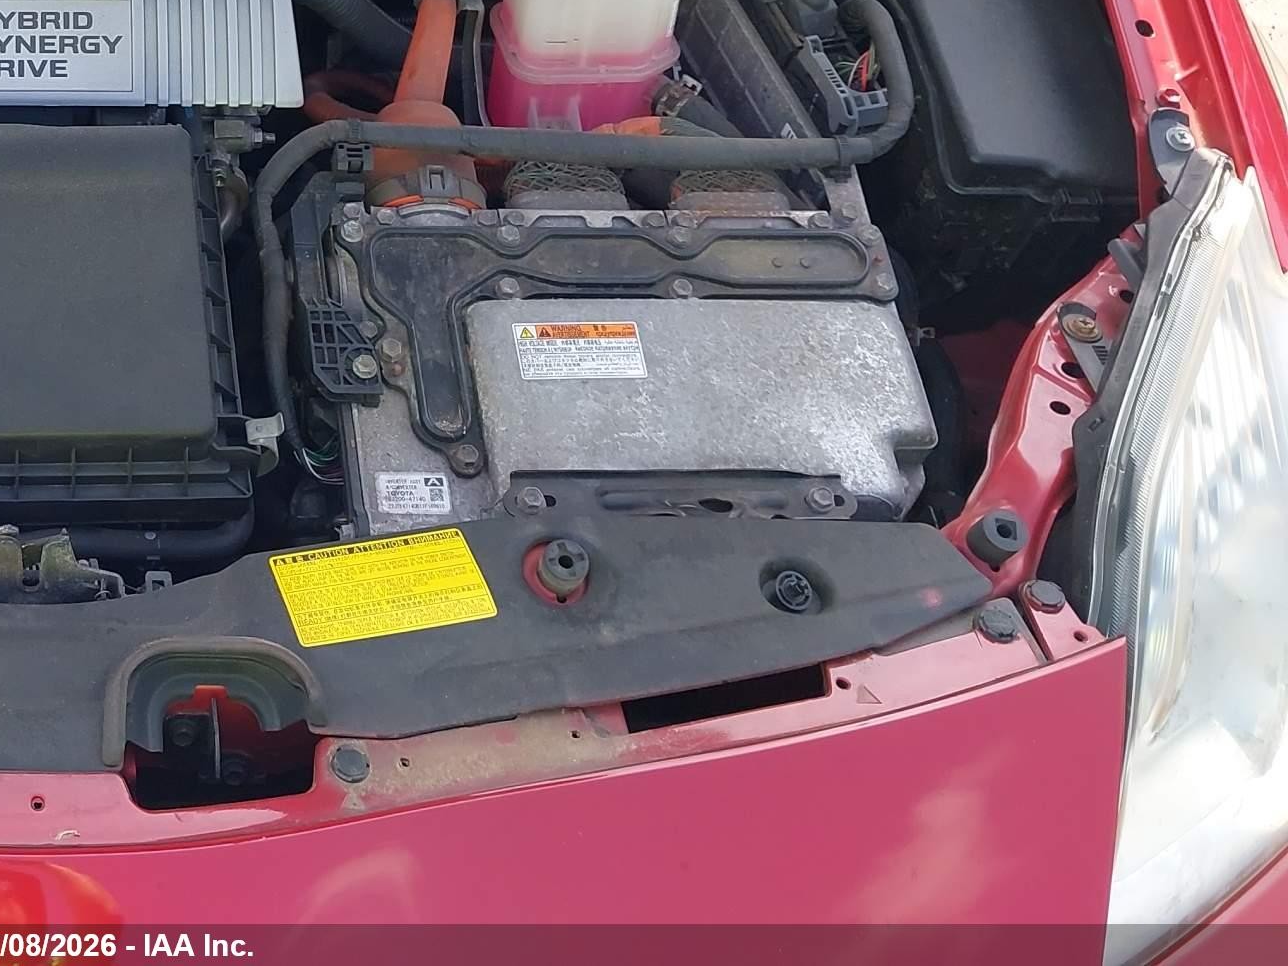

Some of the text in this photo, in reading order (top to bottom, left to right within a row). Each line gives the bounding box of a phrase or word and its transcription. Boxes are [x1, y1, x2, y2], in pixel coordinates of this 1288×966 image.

[308, 547, 349, 561] CAUTION
[353, 538, 404, 555] ATTENTION
[409, 530, 460, 546] ВНИМАНИЕ
